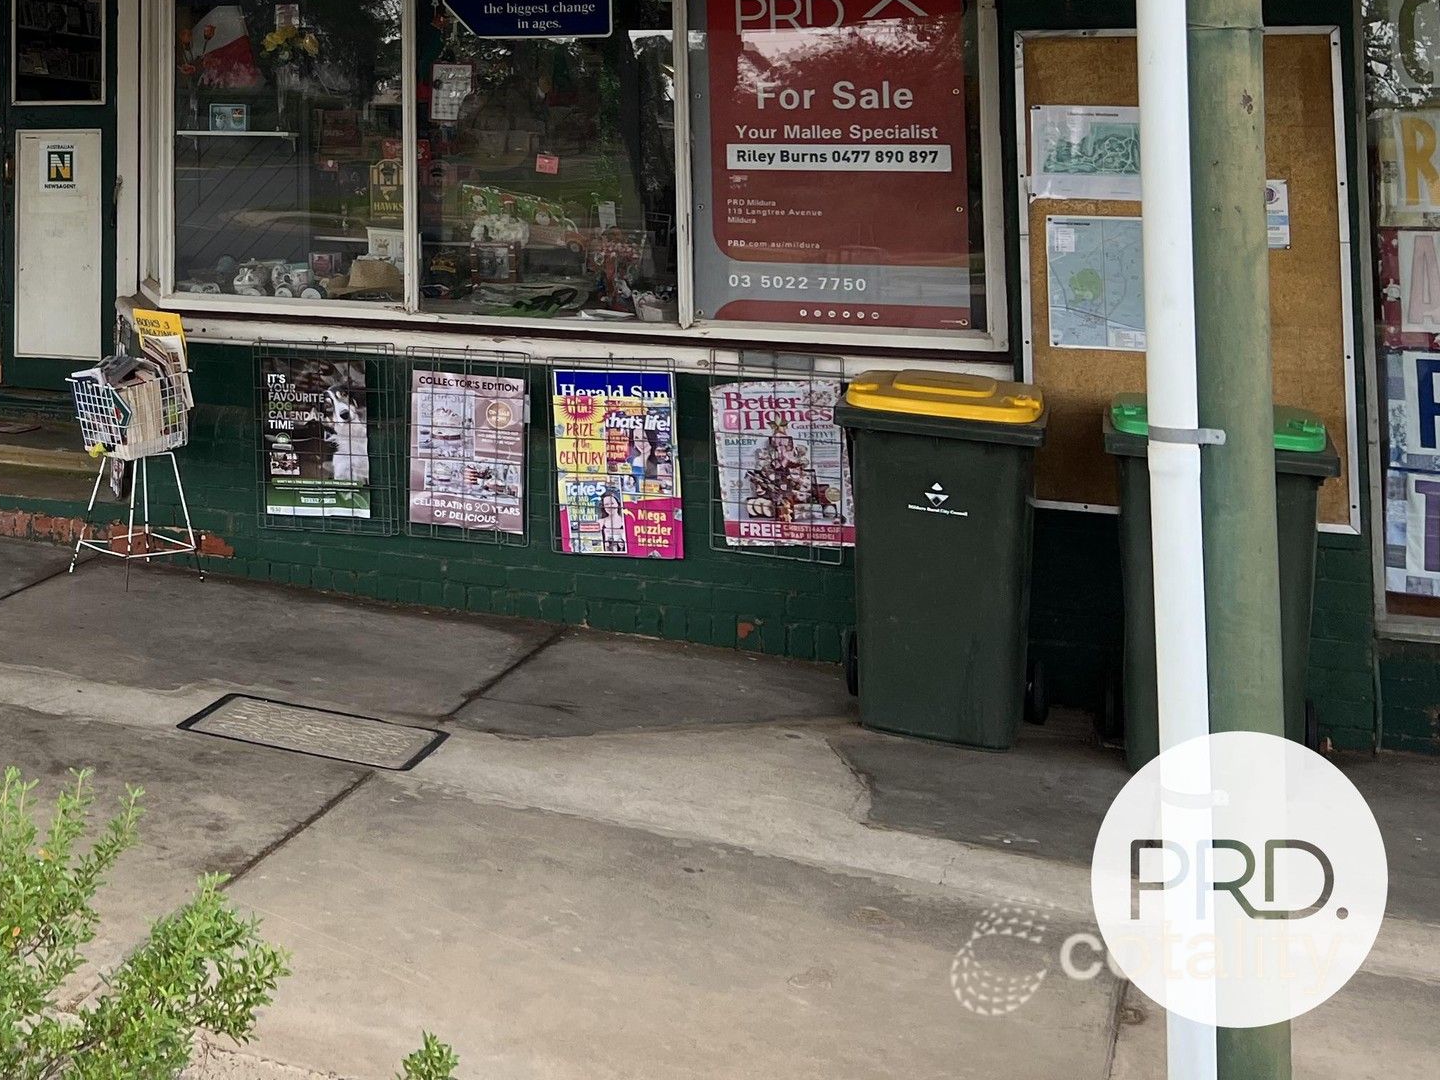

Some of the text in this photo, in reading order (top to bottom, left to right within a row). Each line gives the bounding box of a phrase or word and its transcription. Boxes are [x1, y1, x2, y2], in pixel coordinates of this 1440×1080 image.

[484, 1, 596, 15] the biggest change
[517, 19, 561, 31] in ages.
[757, 81, 913, 110] For Sale
[735, 125, 938, 141] Your Mallee Specialist
[737, 149, 939, 165] Riley Burns 0477 890 897
[728, 275, 867, 292] 03 5022 7750
[267, 373, 286, 383] IT'S
[419, 376, 519, 392] COLLECTOR'S EDITION
[267, 383, 296, 393] YOUR
[560, 384, 668, 398] Herald Sun
[268, 392, 324, 402] FAVOURITE
[724, 392, 801, 410] Better
[269, 401, 292, 410] DOG
[268, 410, 325, 421] CALENDAR
[645, 414, 670, 431] life!
[743, 408, 832, 430] Homes
[268, 420, 294, 430] TIME
[566, 422, 594, 437] PRIZE
[725, 438, 758, 446] BAKERY
[559, 451, 604, 465] CENTURY
[434, 510, 446, 518] OF
[475, 503, 490, 513] 20
[491, 506, 520, 516] YEARS
[638, 509, 667, 523] Mega
[633, 525, 672, 537] puzzler
[740, 522, 782, 538] FREE
